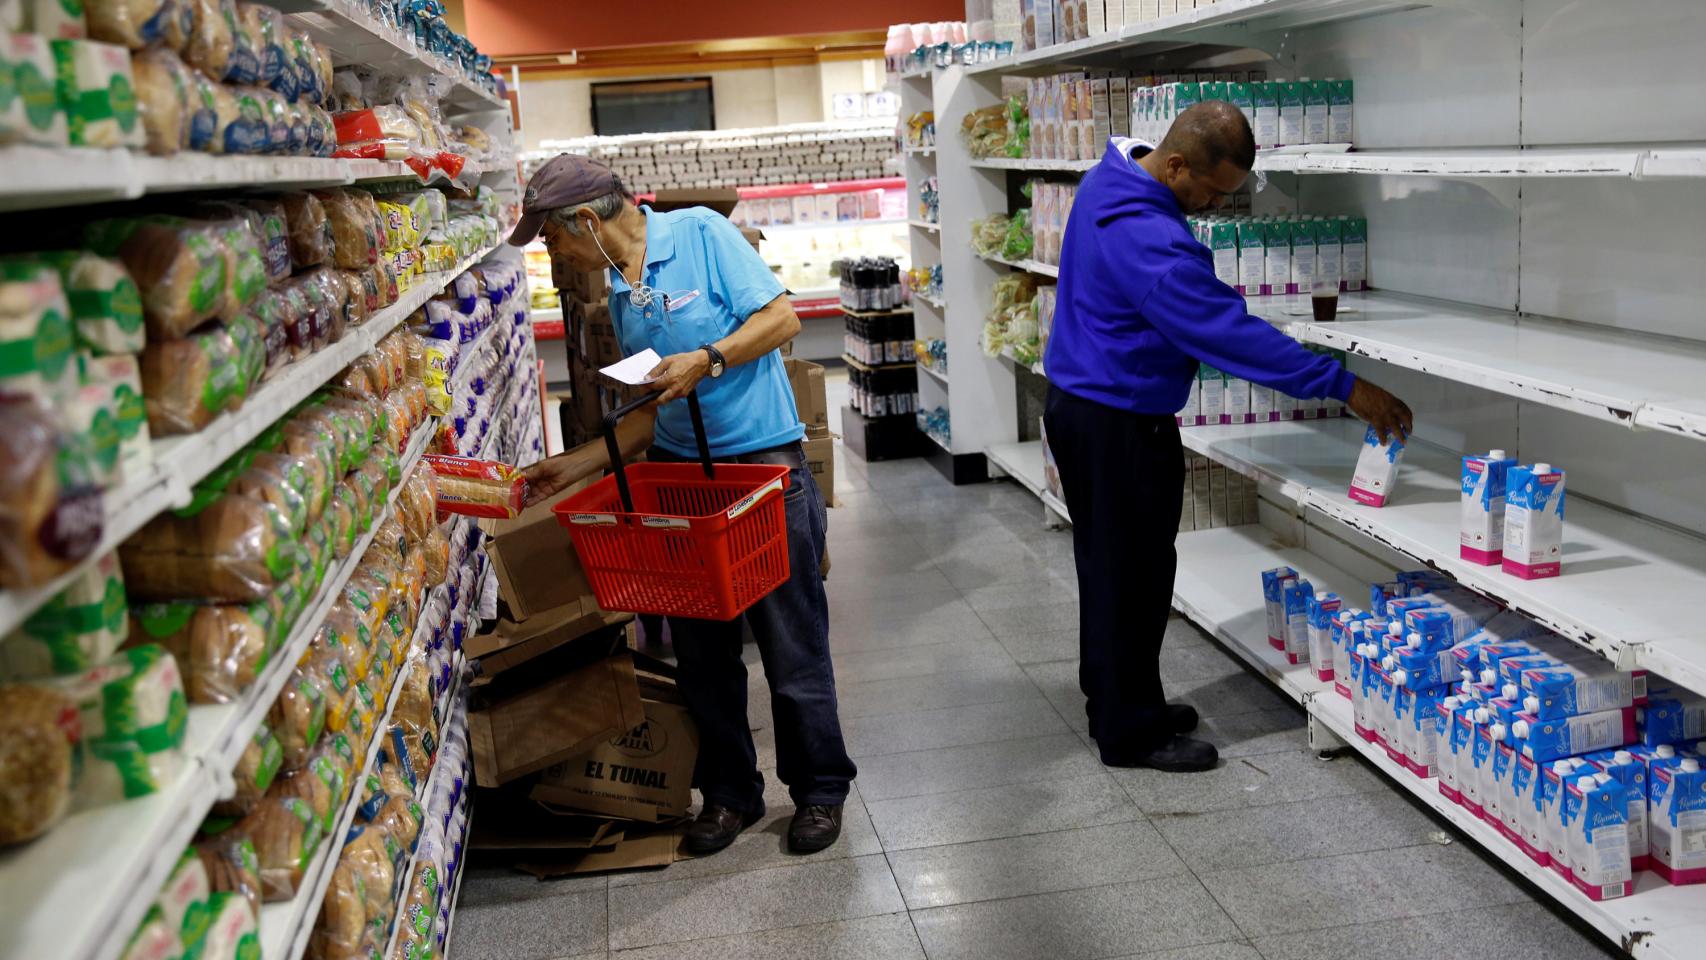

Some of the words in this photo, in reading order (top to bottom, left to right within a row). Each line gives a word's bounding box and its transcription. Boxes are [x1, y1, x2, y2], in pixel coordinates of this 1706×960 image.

[439, 457, 469, 466] Blanco
[584, 760, 604, 779] EL
[609, 764, 669, 790] TUNAL
